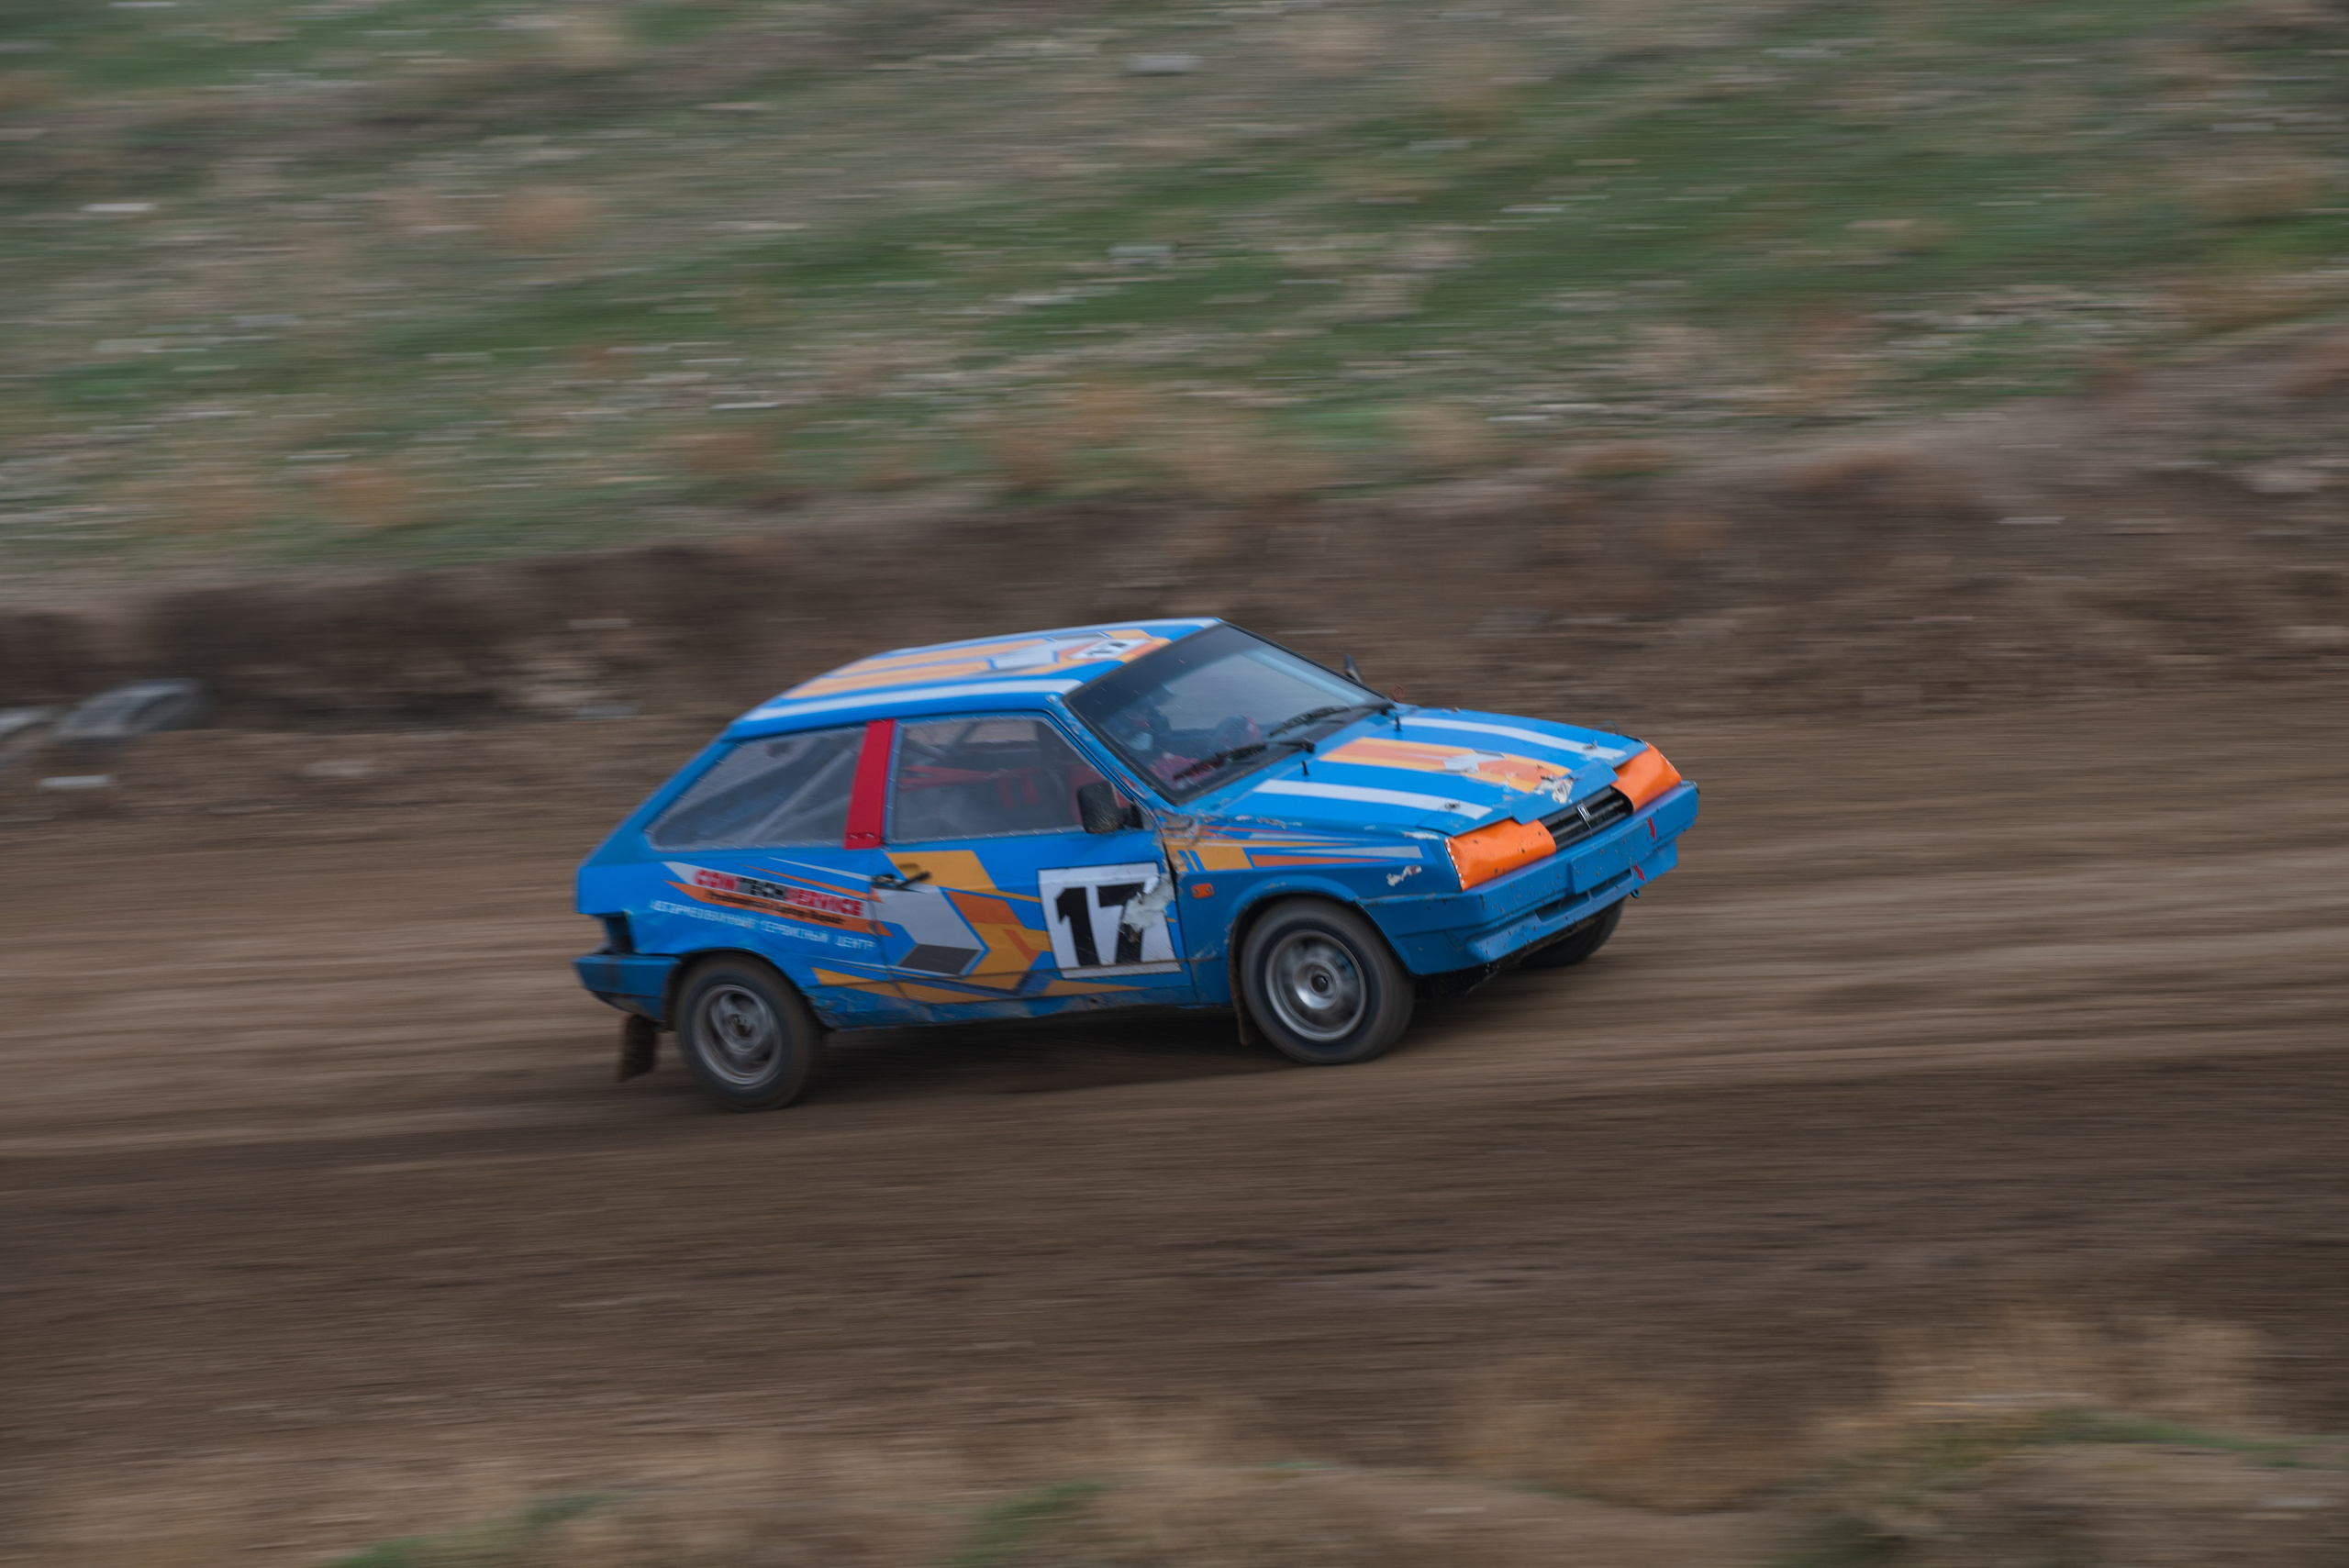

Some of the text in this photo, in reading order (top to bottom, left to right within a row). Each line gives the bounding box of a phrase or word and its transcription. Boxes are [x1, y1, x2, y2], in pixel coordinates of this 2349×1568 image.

[760, 920, 829, 943] СЕРВИСНЫЙ
[835, 934, 876, 951] ЦЕНТР
[1056, 883, 1145, 967] 17
